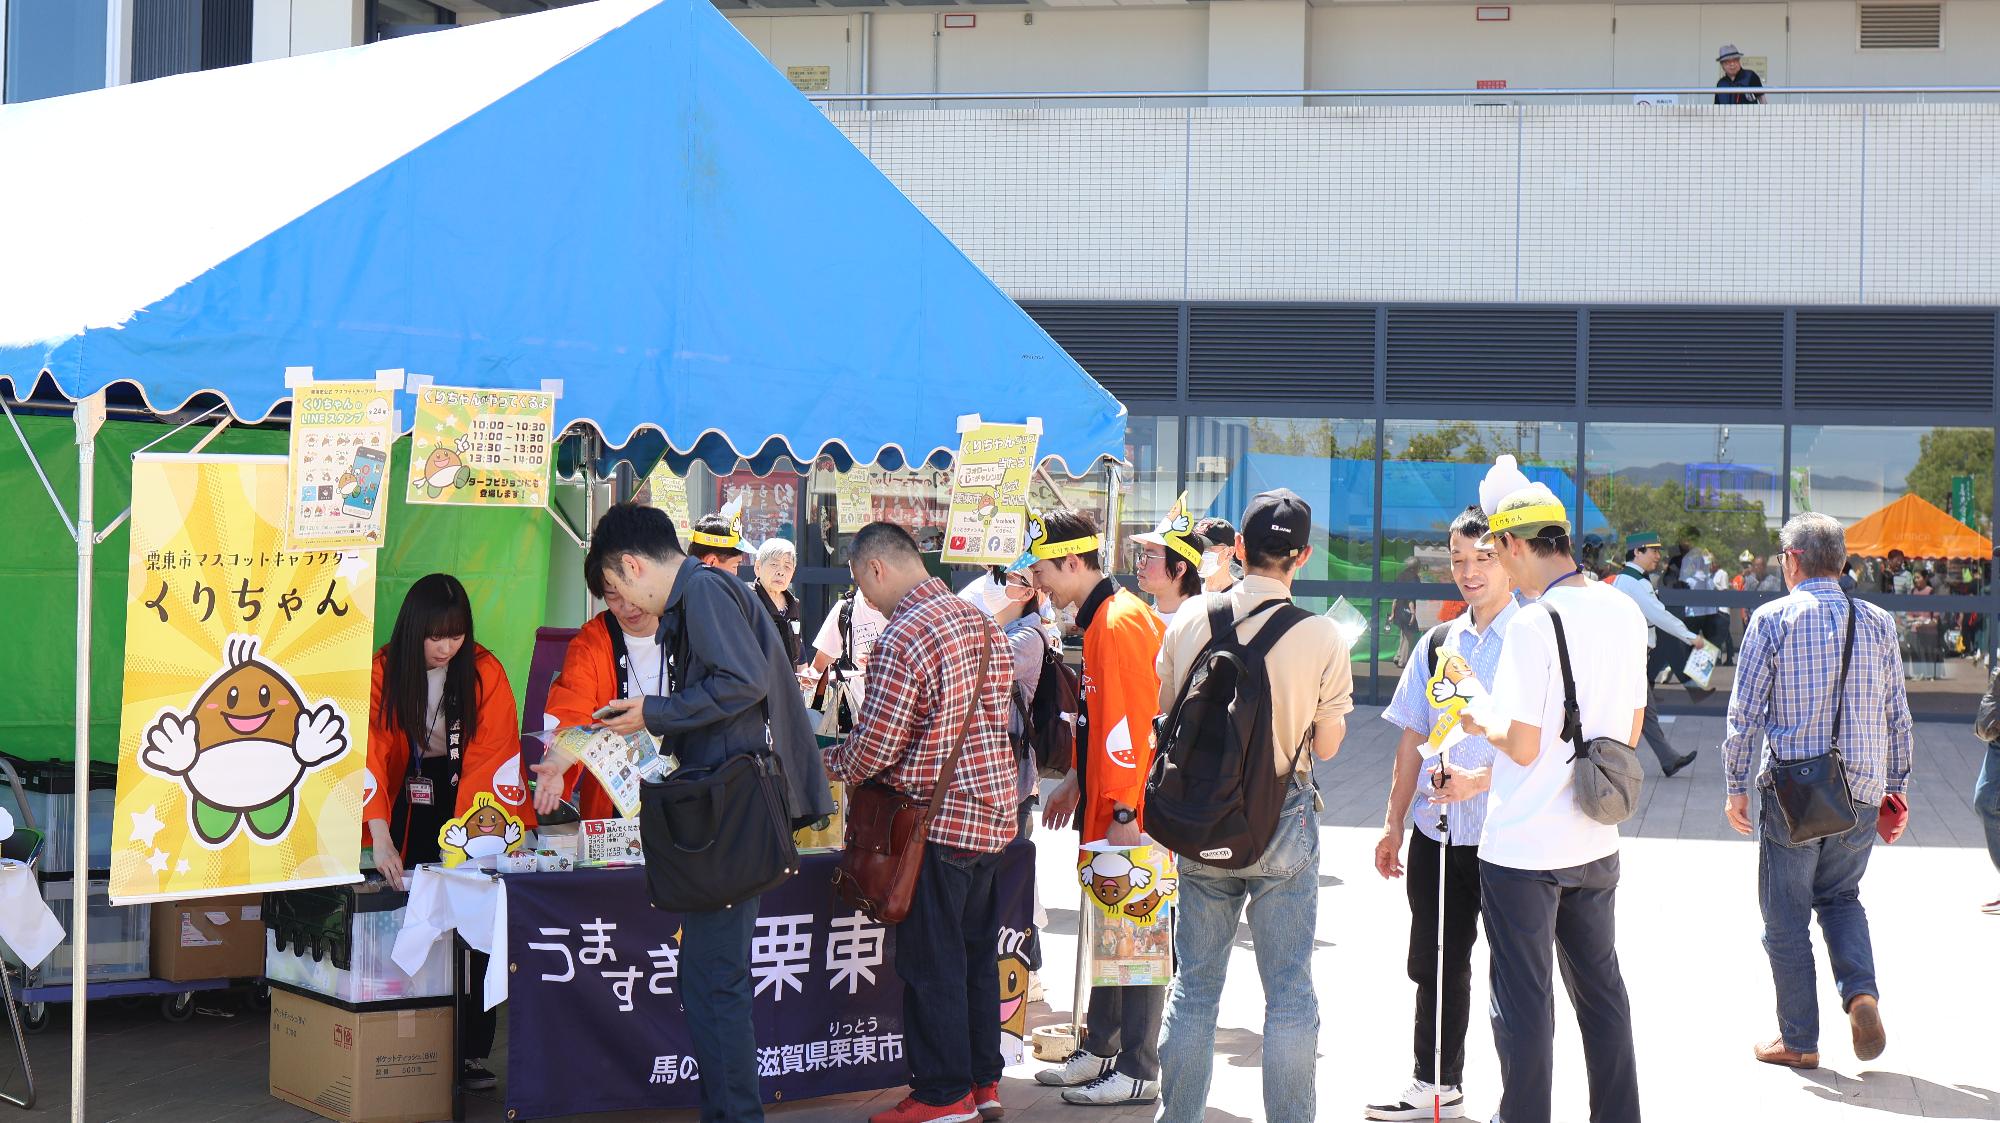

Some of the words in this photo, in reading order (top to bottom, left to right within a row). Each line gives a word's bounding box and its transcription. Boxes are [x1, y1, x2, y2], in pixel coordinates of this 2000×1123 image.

[302, 397, 362, 411] くりちゃんの
[423, 389, 548, 408] くりちゃんがやってくるよ
[301, 413, 326, 425] LINE
[327, 413, 365, 424] スタンプ
[146, 550, 359, 571] 栗東市マスコットキャラクター
[145, 577, 349, 623] くりちゃん
[606, 825, 640, 833] 選んでくださ
[750, 910, 886, 1002] 栗東
[828, 1016, 880, 1038] りっとう
[649, 1054, 700, 1085] 馬の
[756, 1032, 903, 1078] 滋賀県栗東市
